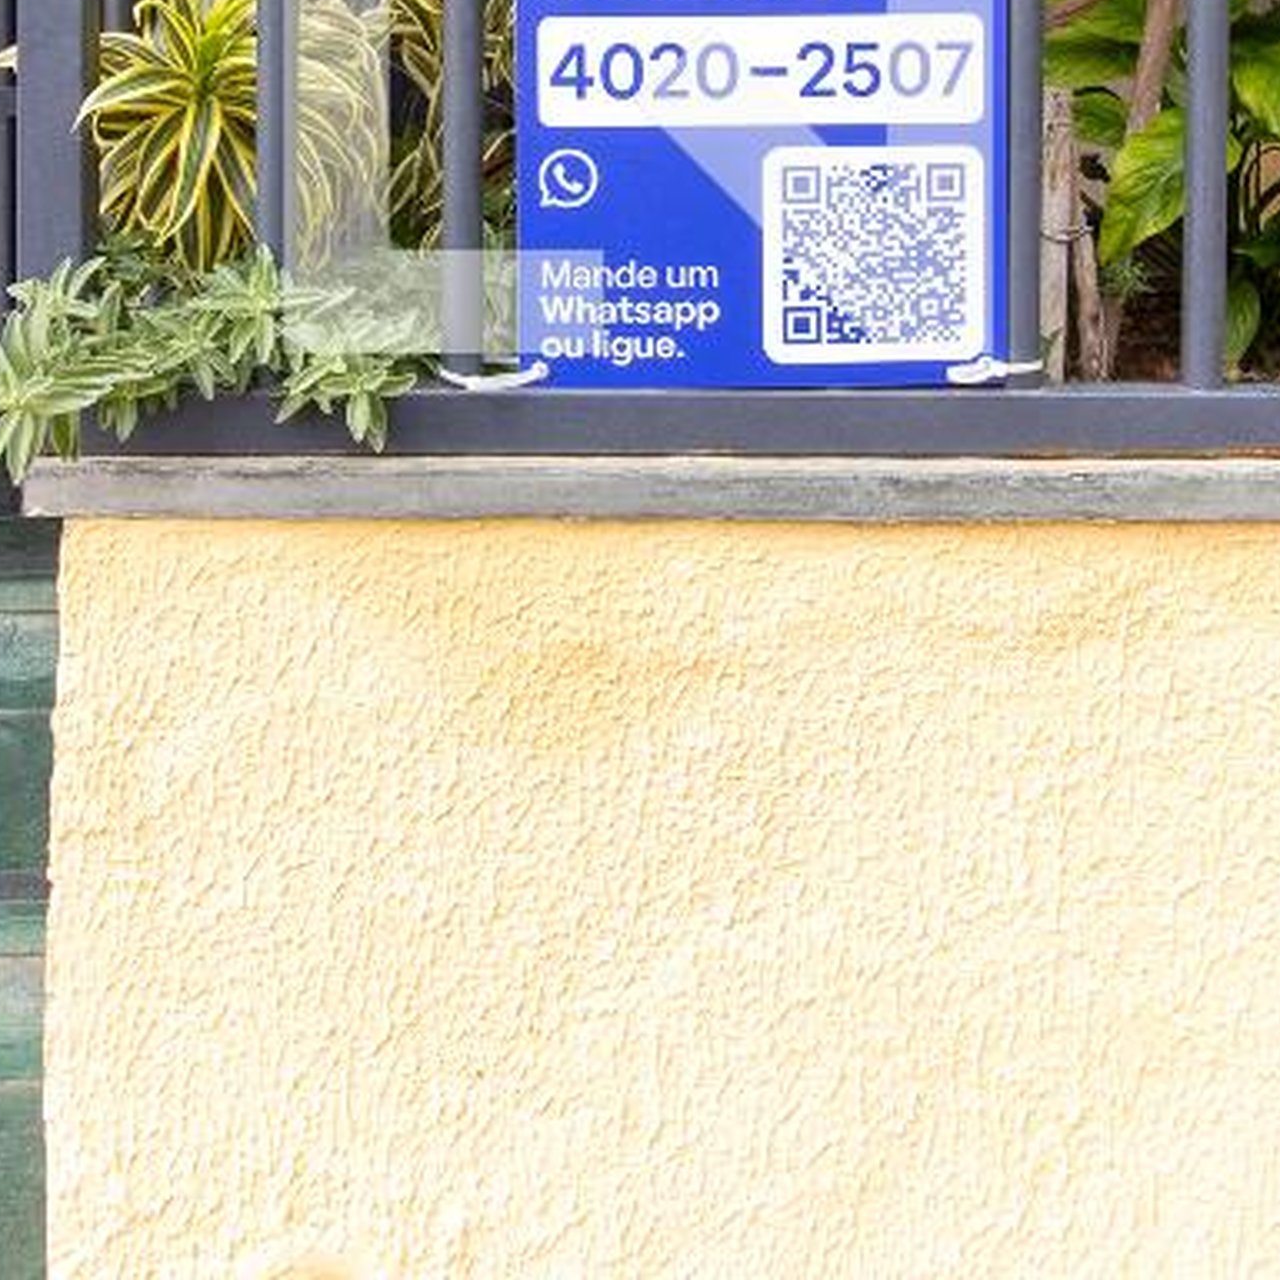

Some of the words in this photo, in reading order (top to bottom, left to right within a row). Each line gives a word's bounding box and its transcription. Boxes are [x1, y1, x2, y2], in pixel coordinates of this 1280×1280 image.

[549, 41, 974, 100] 4020-2507
[541, 259, 659, 289] Mande
[666, 267, 719, 289] um
[541, 296, 720, 330] Whatsapp
[541, 337, 585, 360] ou
[592, 331, 685, 366] ligue.
